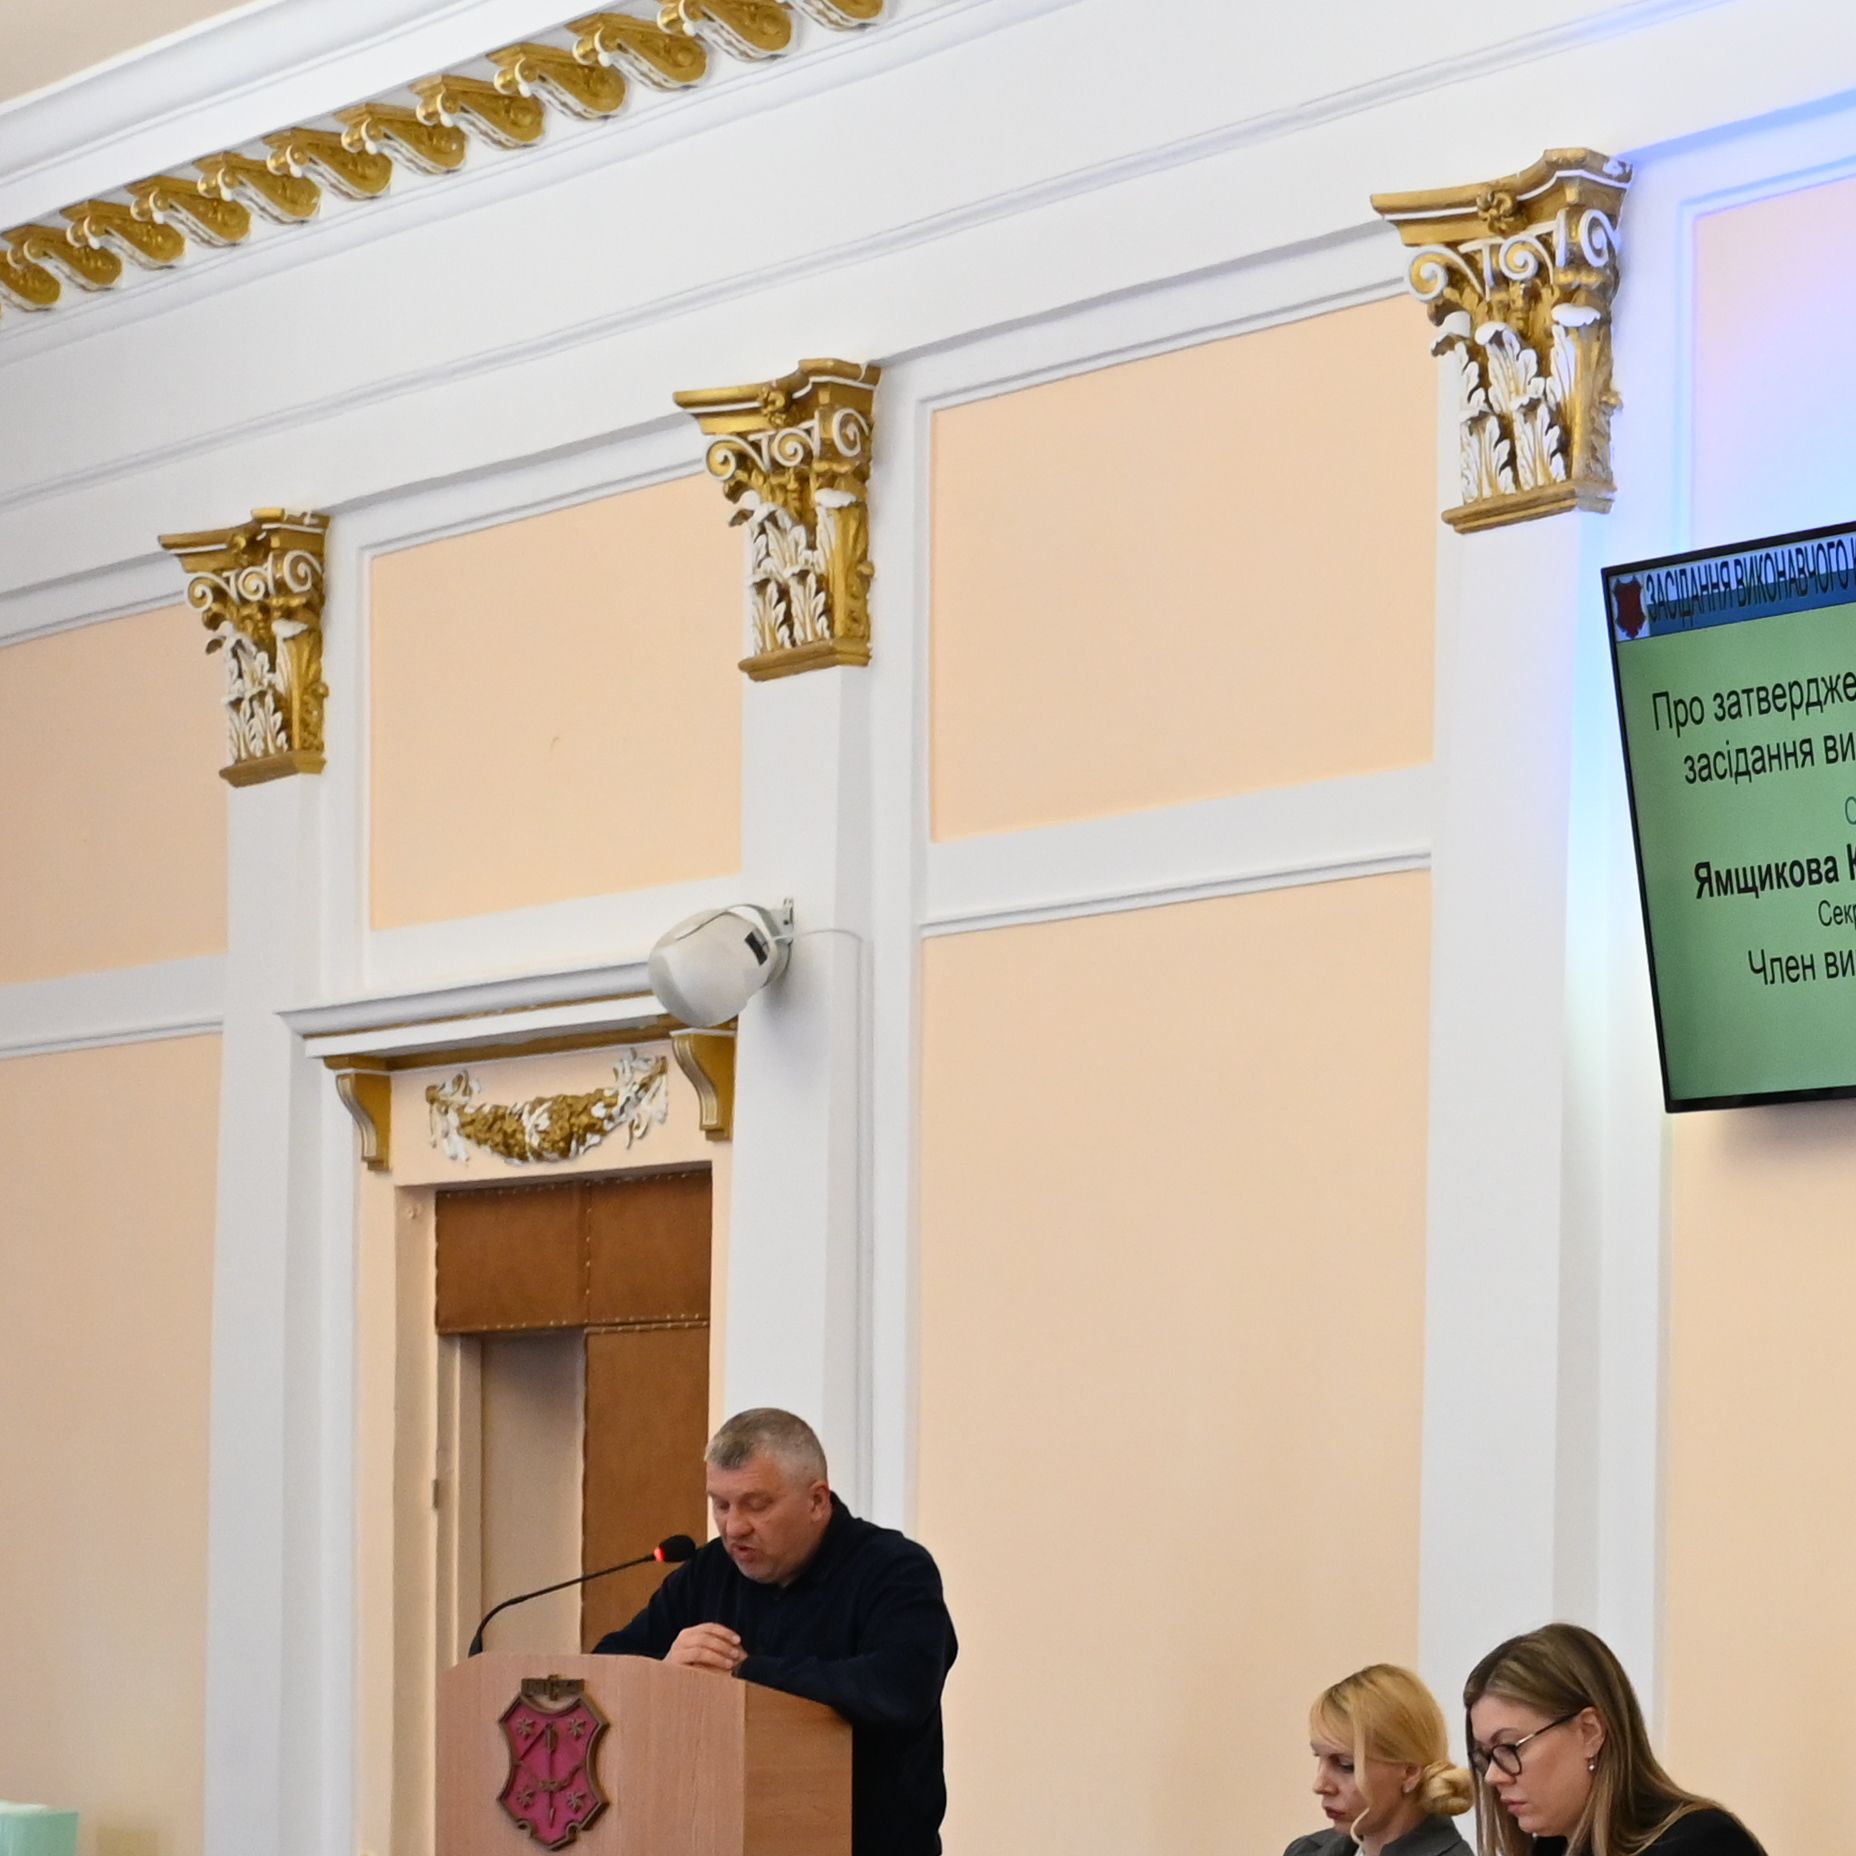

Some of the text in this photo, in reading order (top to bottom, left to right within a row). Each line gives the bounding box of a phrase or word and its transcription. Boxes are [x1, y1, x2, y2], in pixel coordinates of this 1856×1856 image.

[1646, 560, 1732, 627] ЗАСІДАННЯ
[1735, 539, 1848, 607] ВИКОНАВЧОГО
[1651, 691, 1705, 738] Про
[1683, 738, 1815, 785] засідання
[1694, 854, 1840, 900] Ямщикова
[1748, 949, 1816, 986] Член
